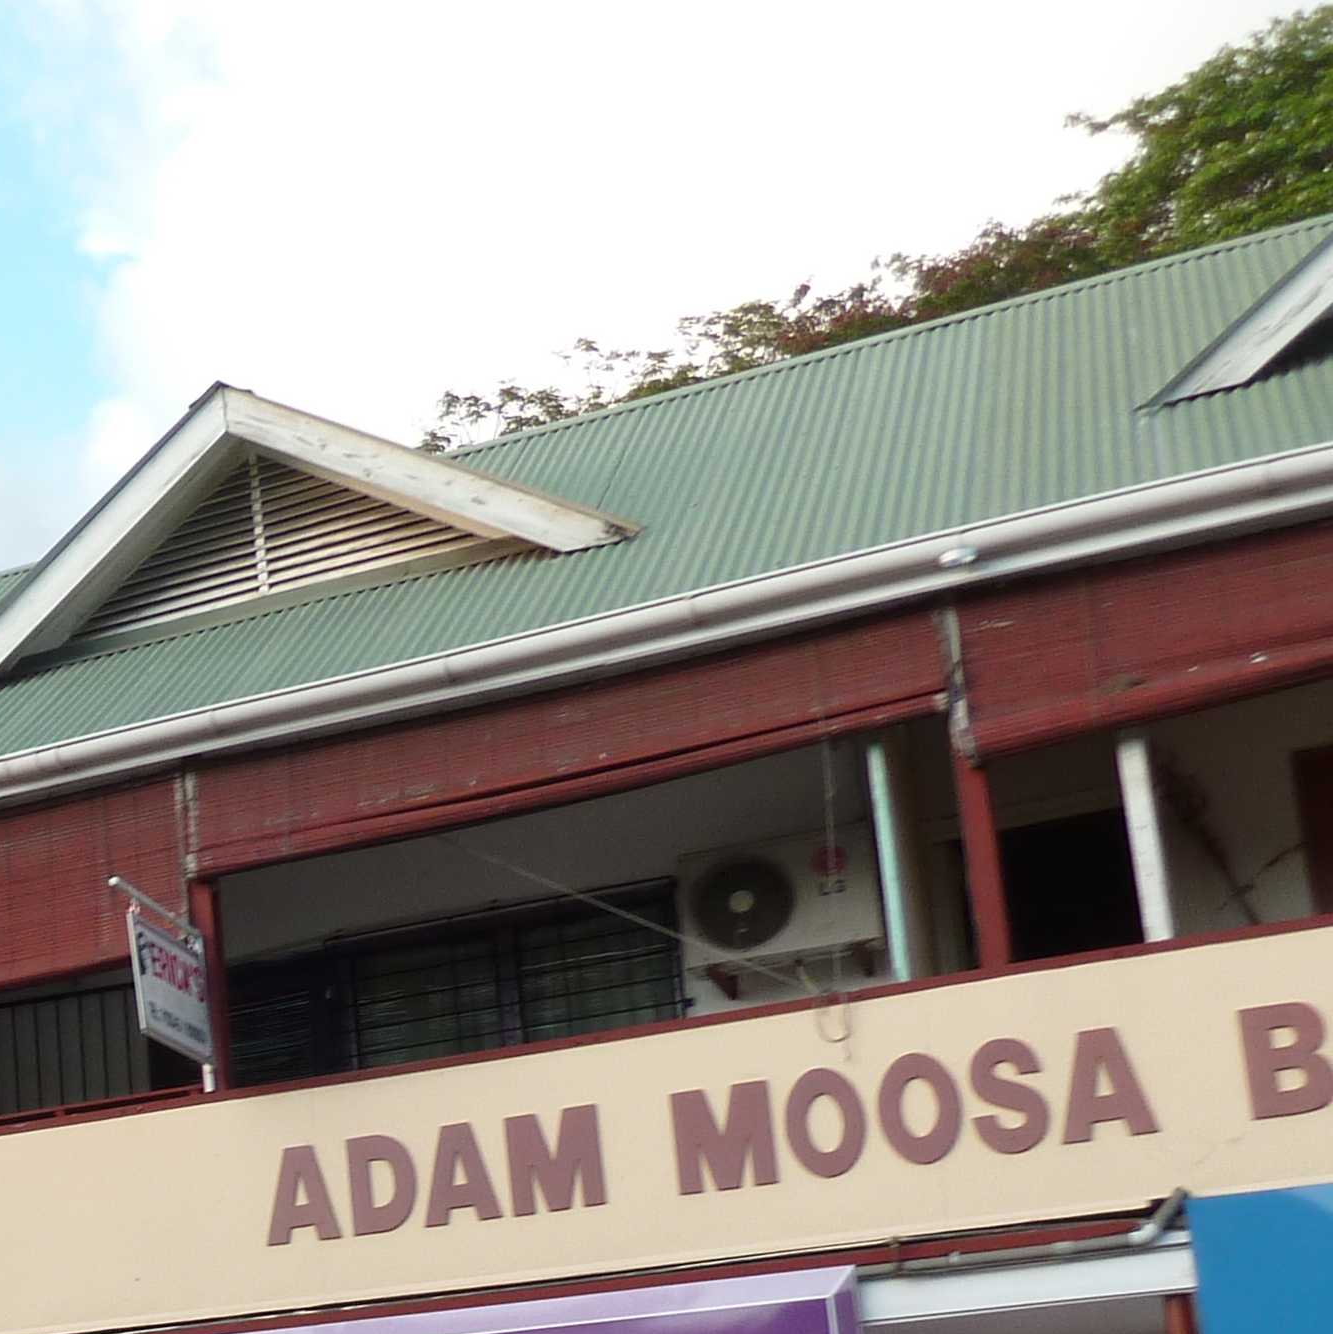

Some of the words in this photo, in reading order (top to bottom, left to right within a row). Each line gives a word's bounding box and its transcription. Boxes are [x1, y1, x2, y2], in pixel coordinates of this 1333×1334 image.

[267, 1103, 609, 1246] ADAM
[668, 1026, 1161, 1195] MOOSA
[1237, 1001, 1333, 1120] B
